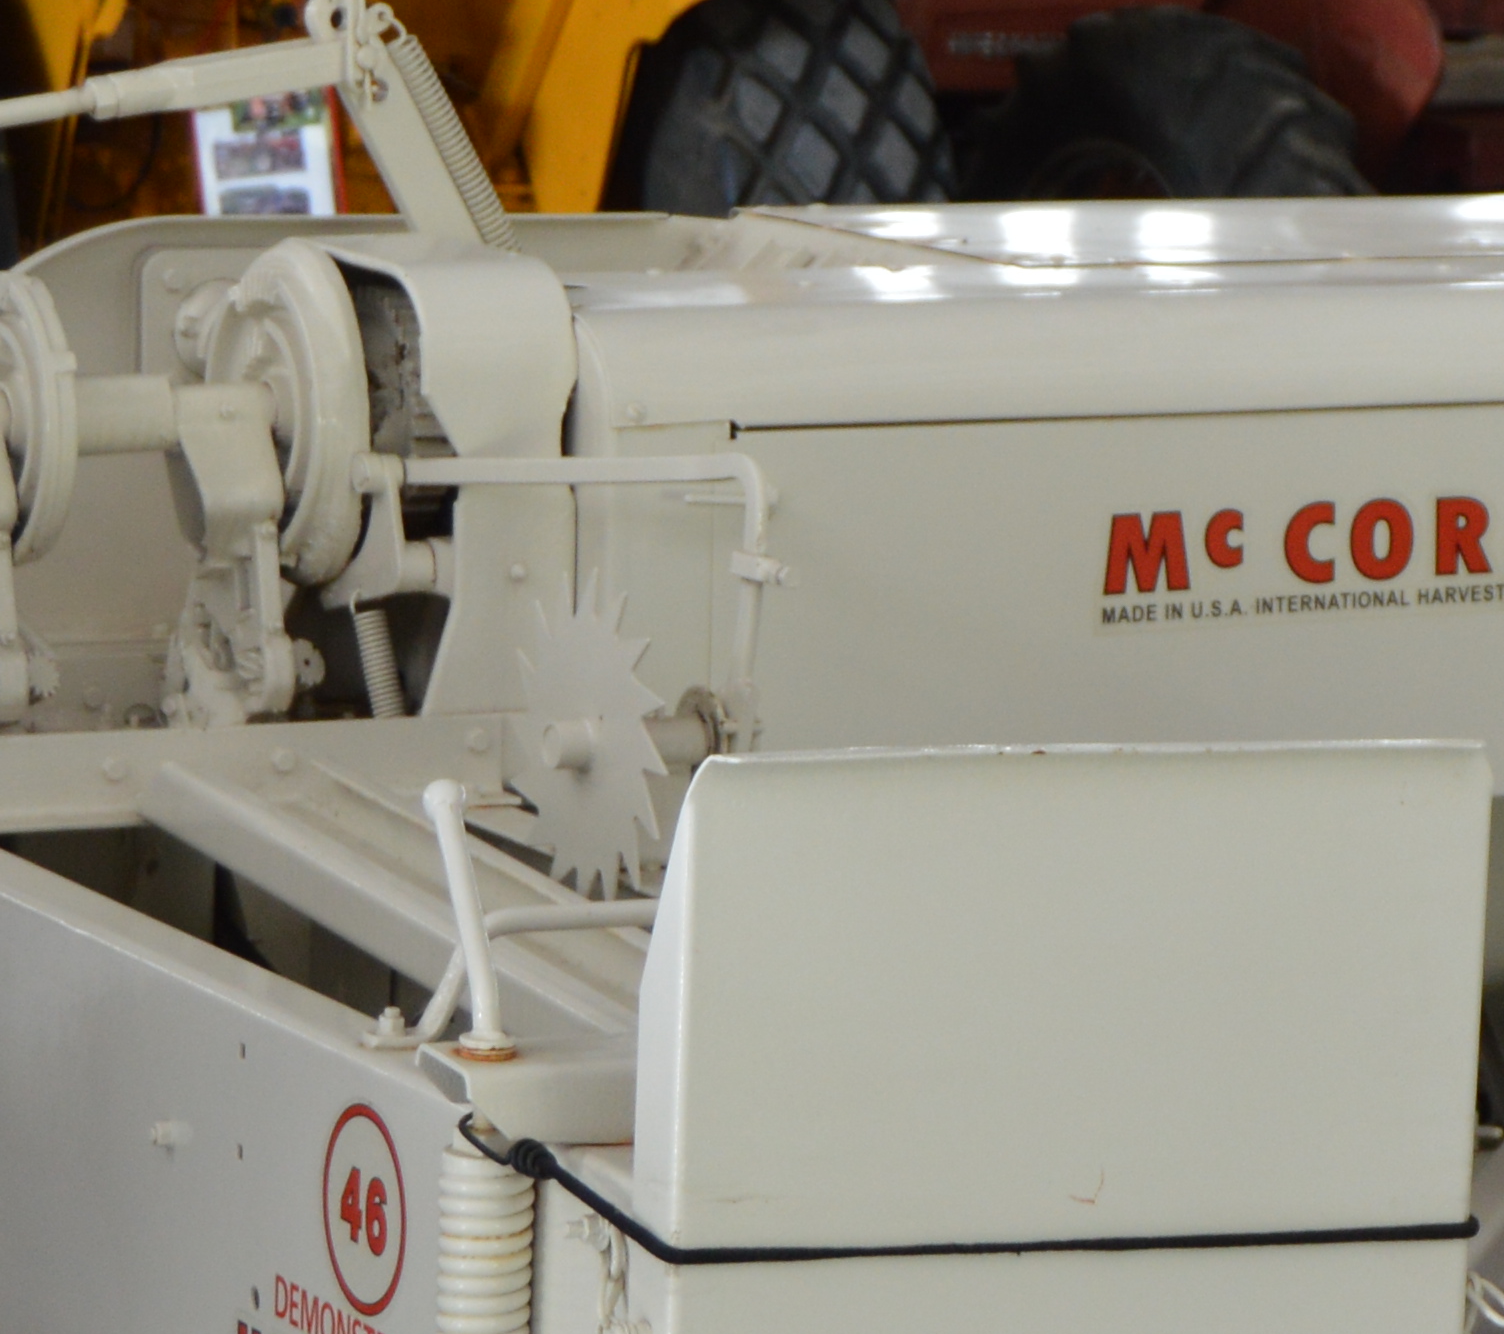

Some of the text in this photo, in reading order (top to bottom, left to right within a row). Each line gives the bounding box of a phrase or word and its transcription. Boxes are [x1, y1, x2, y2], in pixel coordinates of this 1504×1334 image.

[1101, 603, 1157, 624] MADE
[1164, 601, 1183, 620] IN
[1254, 590, 1410, 615] INTERNATIONAL
[340, 1166, 388, 1256] 46
